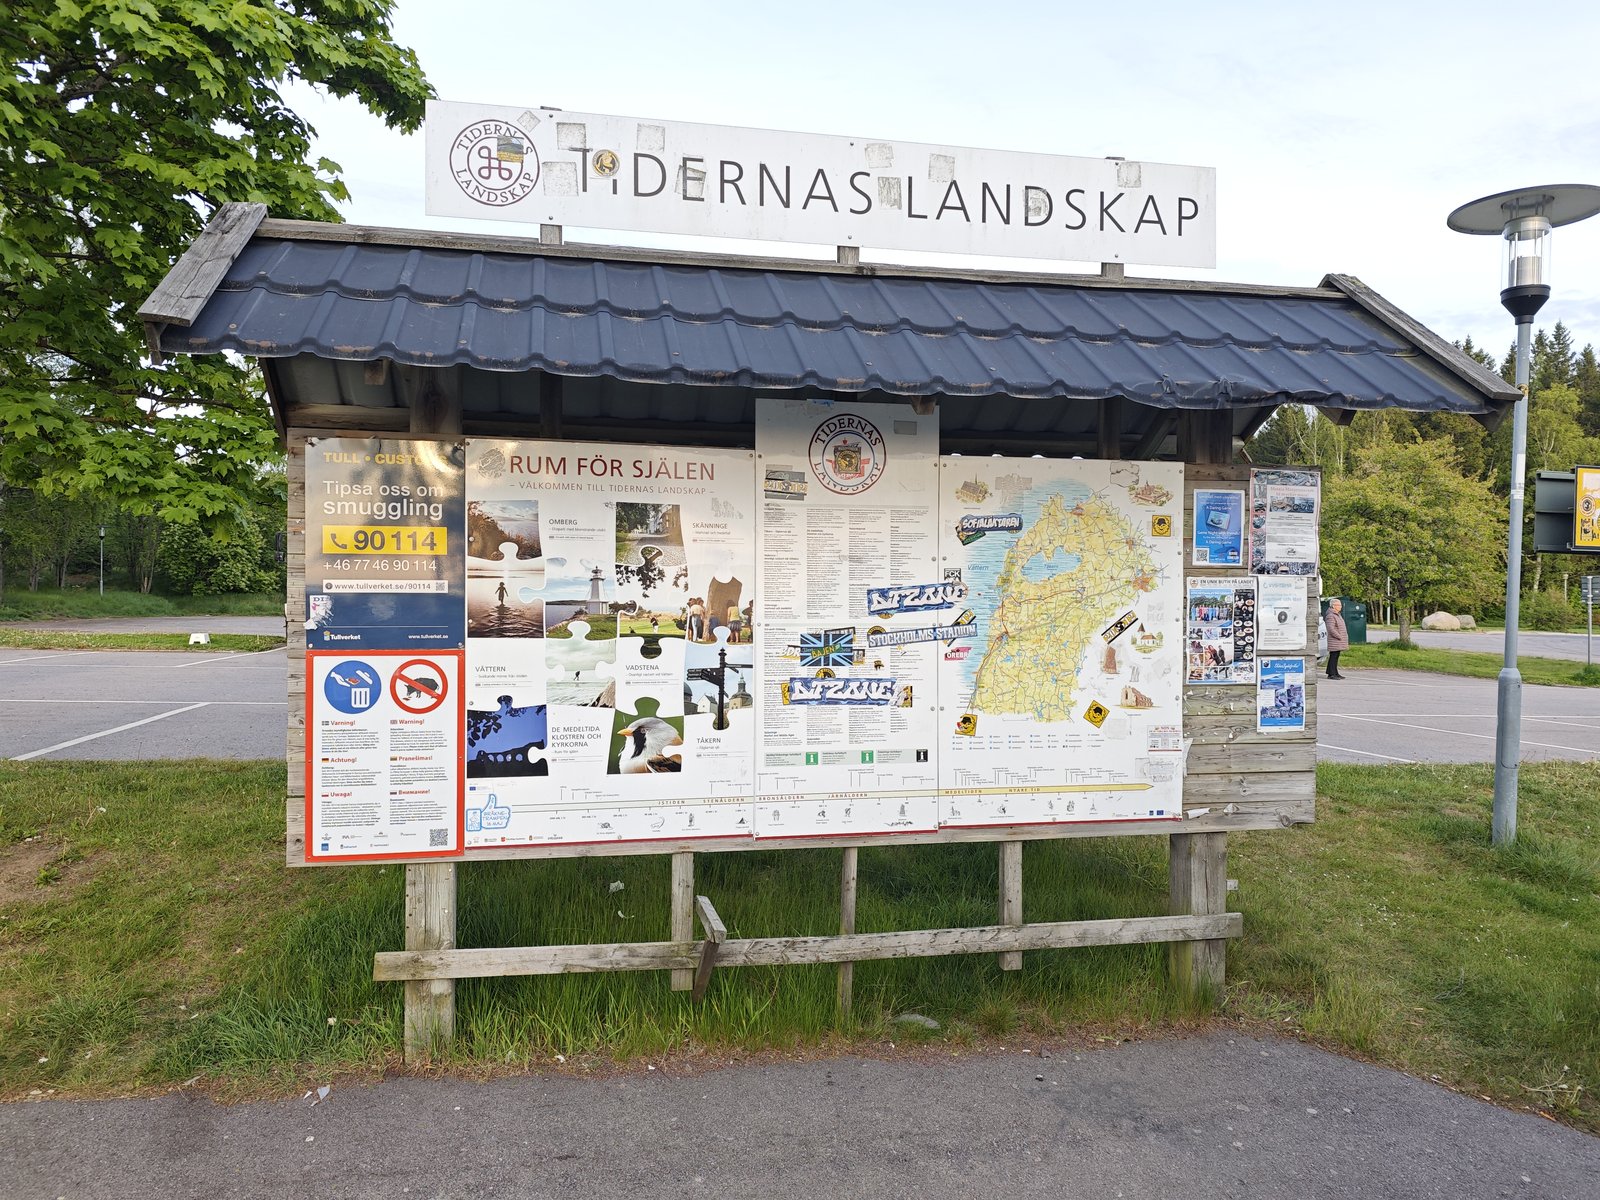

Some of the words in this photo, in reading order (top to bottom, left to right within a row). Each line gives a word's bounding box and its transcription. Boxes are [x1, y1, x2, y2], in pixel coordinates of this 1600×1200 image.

[456, 124, 533, 155] TIDERNS
[456, 168, 534, 203] LANDSKAP
[907, 176, 1200, 236] LANDSKAP
[815, 417, 881, 446] TIDERNAS
[323, 452, 360, 464] TULL
[509, 455, 567, 475] RUM
[577, 455, 623, 478] FÖR
[632, 457, 715, 481] SJÄLEN
[322, 480, 373, 497] Tipsa
[379, 484, 411, 496] oss
[416, 485, 444, 497] om
[518, 481, 583, 491] VÄLKOMMEN
[587, 482, 605, 492] TILL
[609, 484, 654, 494] TIDERNAS
[657, 486, 706, 495] LANDSKAP
[323, 498, 443, 521] smuggling
[692, 521, 728, 529] SKÄNNINGE
[353, 530, 386, 550] 90
[391, 531, 437, 551] 114
[323, 560, 350, 571] +46
[414, 560, 437, 571] 114
[334, 582, 432, 591] www.tullverket.se/90114
[868, 626, 934, 647] STOCKHOLMS
[936, 624, 976, 640] STADION
[811, 645, 835, 658] BAJEN
